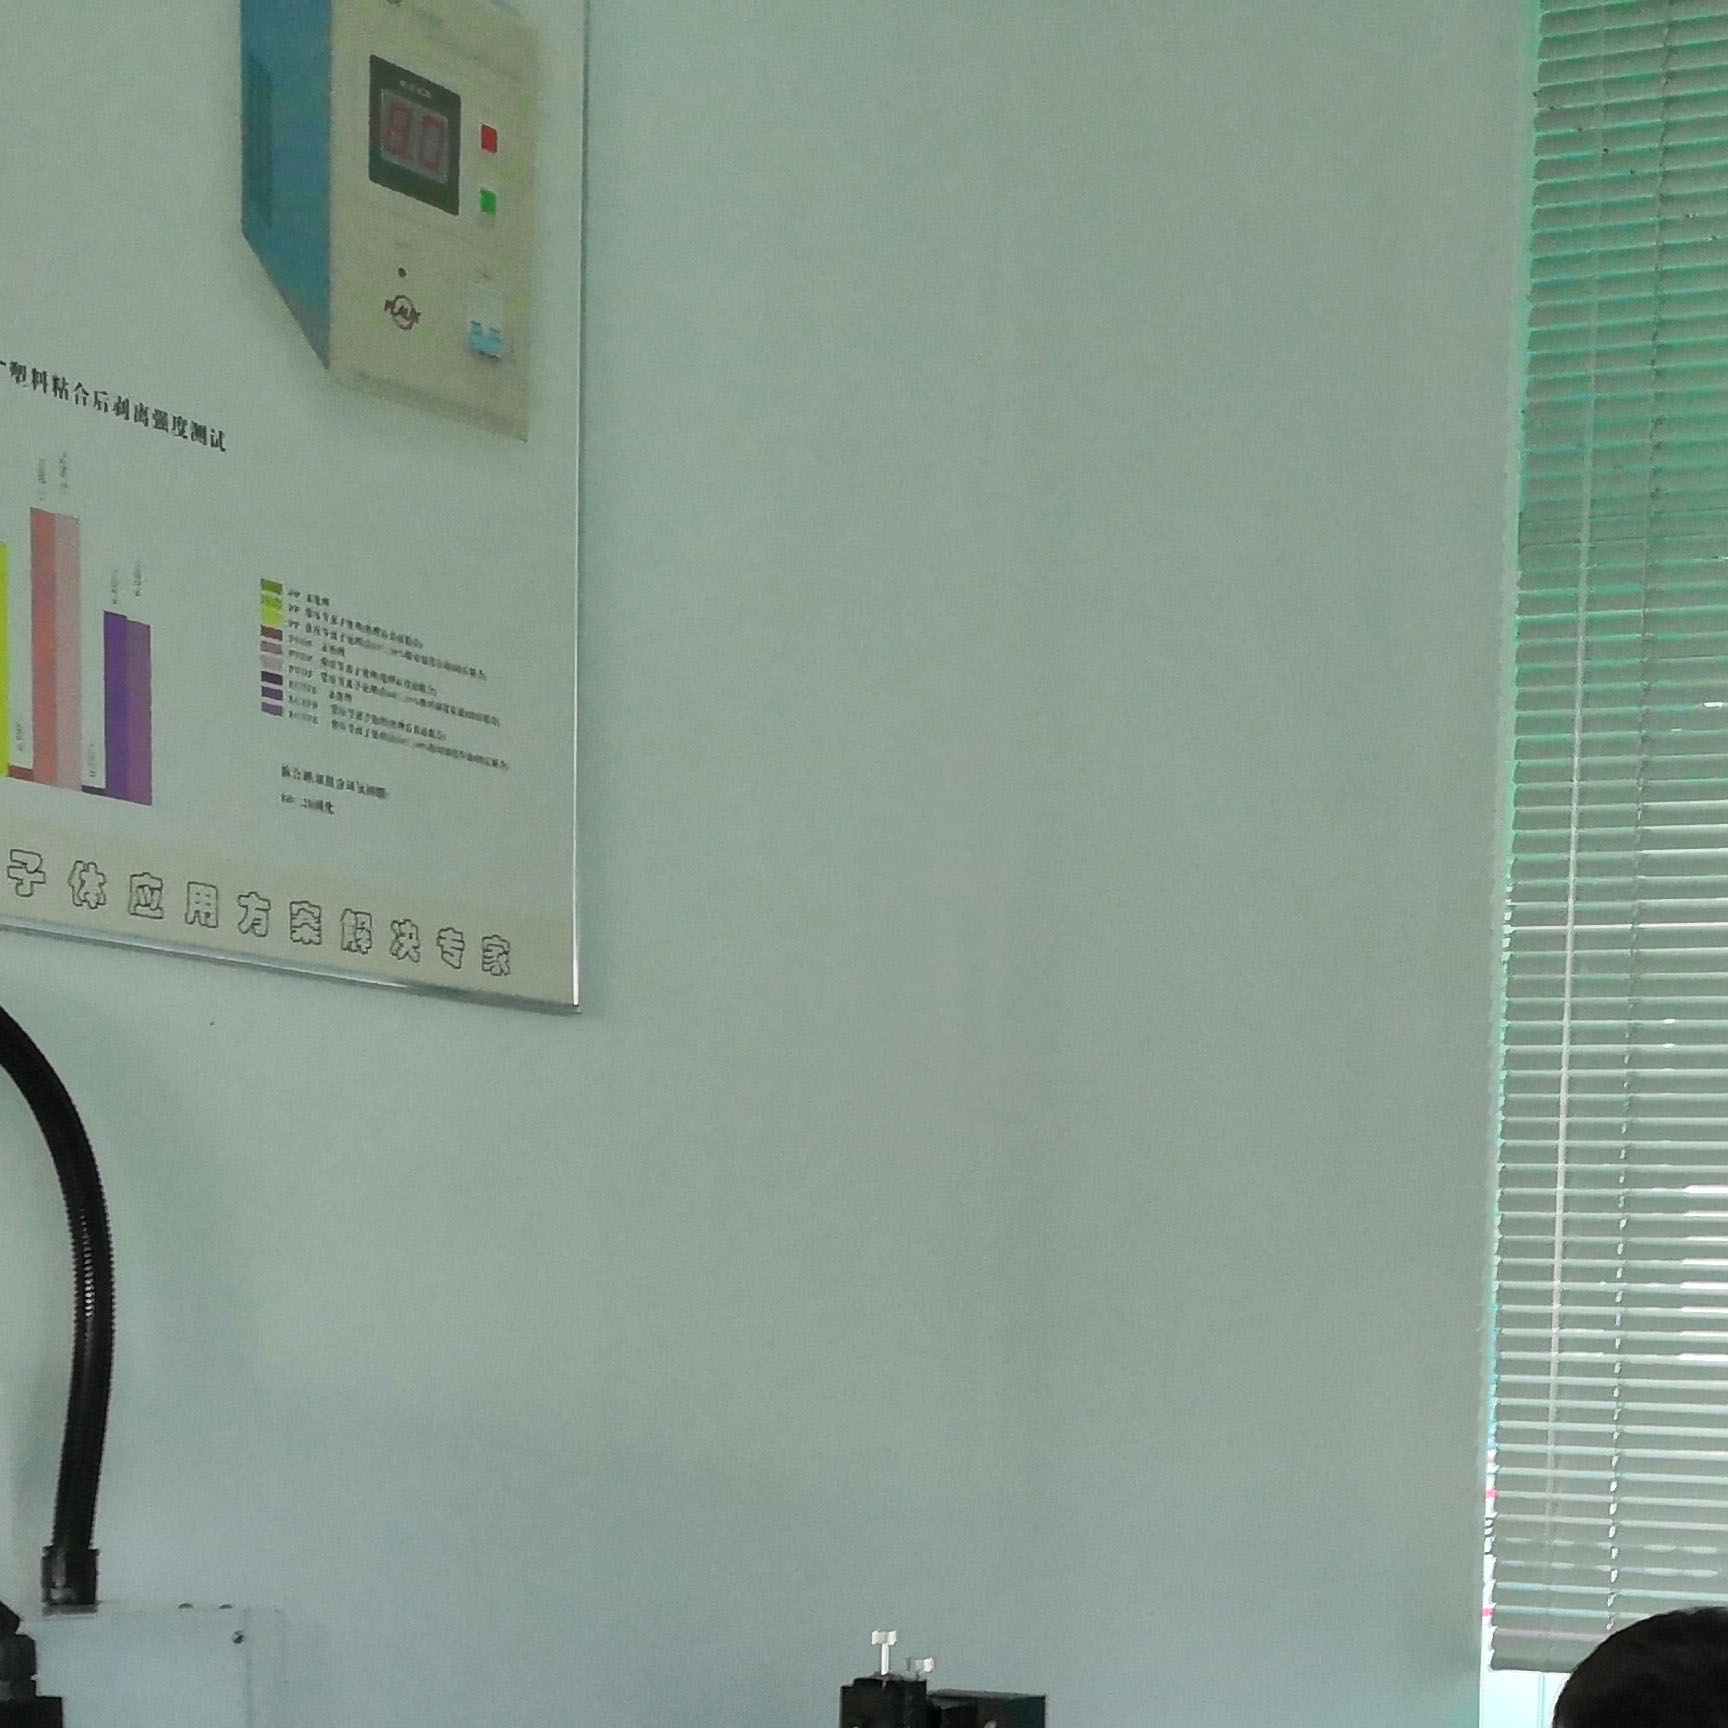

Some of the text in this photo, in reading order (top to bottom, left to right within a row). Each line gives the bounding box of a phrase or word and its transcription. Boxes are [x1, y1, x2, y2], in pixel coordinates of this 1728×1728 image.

[6, 848, 511, 977] 子体应用方案解决专家
